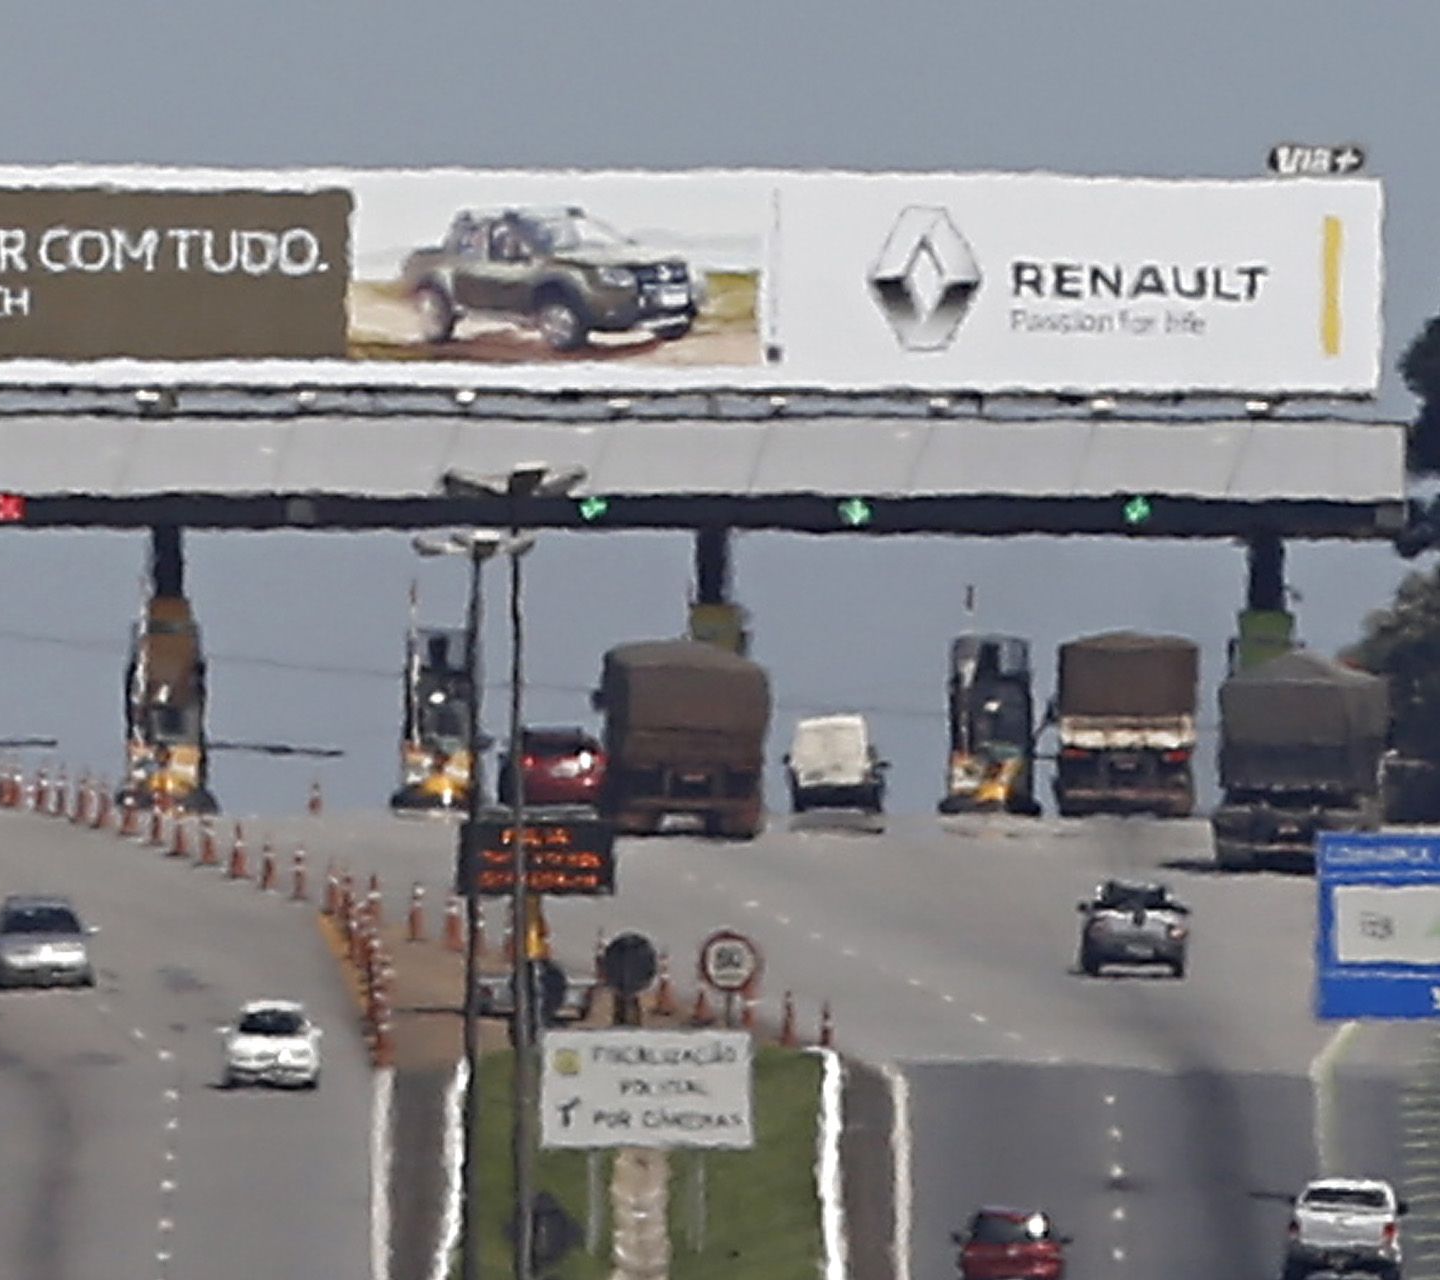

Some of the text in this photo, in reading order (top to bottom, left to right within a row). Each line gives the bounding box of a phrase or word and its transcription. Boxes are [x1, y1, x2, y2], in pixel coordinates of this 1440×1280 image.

[38, 225, 161, 272] COM
[167, 228, 330, 275] TUDO.
[1011, 261, 1270, 301] RENAULT
